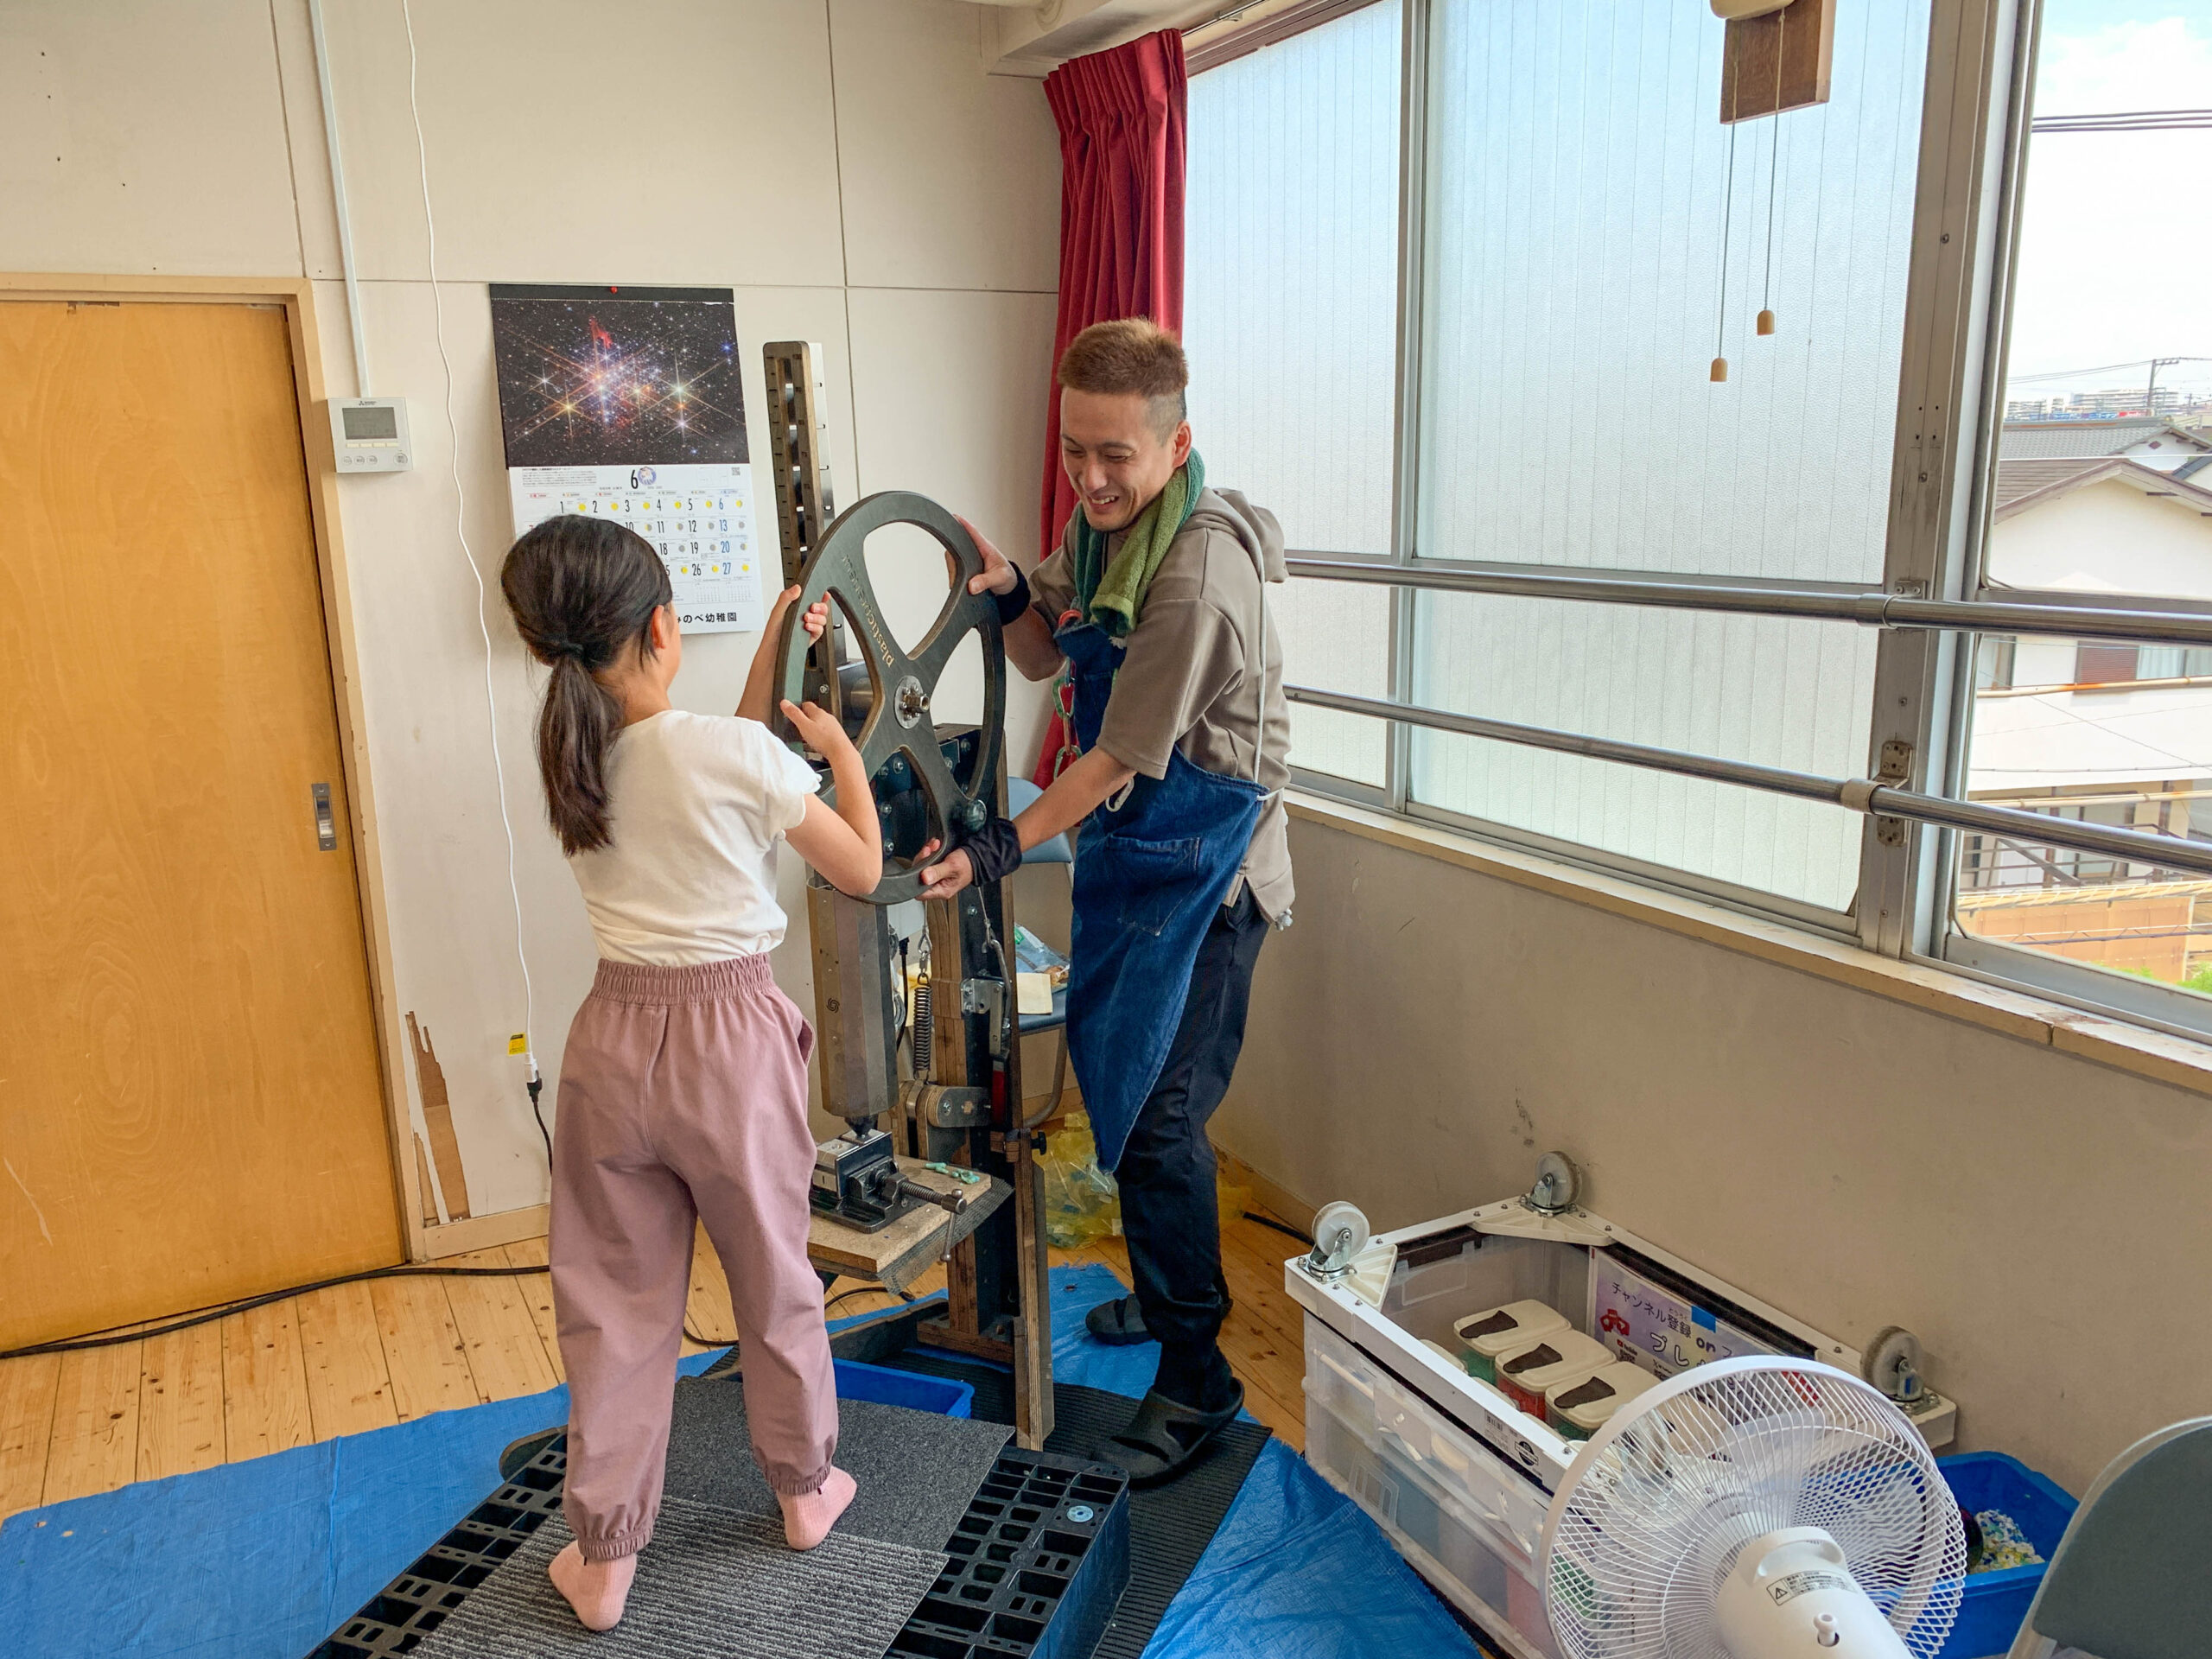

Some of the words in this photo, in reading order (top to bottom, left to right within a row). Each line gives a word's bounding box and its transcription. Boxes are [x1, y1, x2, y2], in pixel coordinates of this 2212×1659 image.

[631, 469, 639, 489] 6
[593, 500, 598, 513] 2
[625, 499, 630, 512] 3
[657, 499, 662, 512] 4
[688, 498, 693, 511] 5
[719, 498, 724, 510] 6
[658, 521, 664, 533] 11
[689, 520, 697, 532] 12
[720, 519, 728, 531] 13
[659, 543, 668, 556] 18
[690, 542, 699, 554] 19
[721, 541, 730, 553] 20
[692, 563, 702, 576] 26
[722, 563, 732, 575] 27
[842, 554, 895, 668] plasticpreneur
[1612, 1282, 1692, 1338] チャンネル登録
